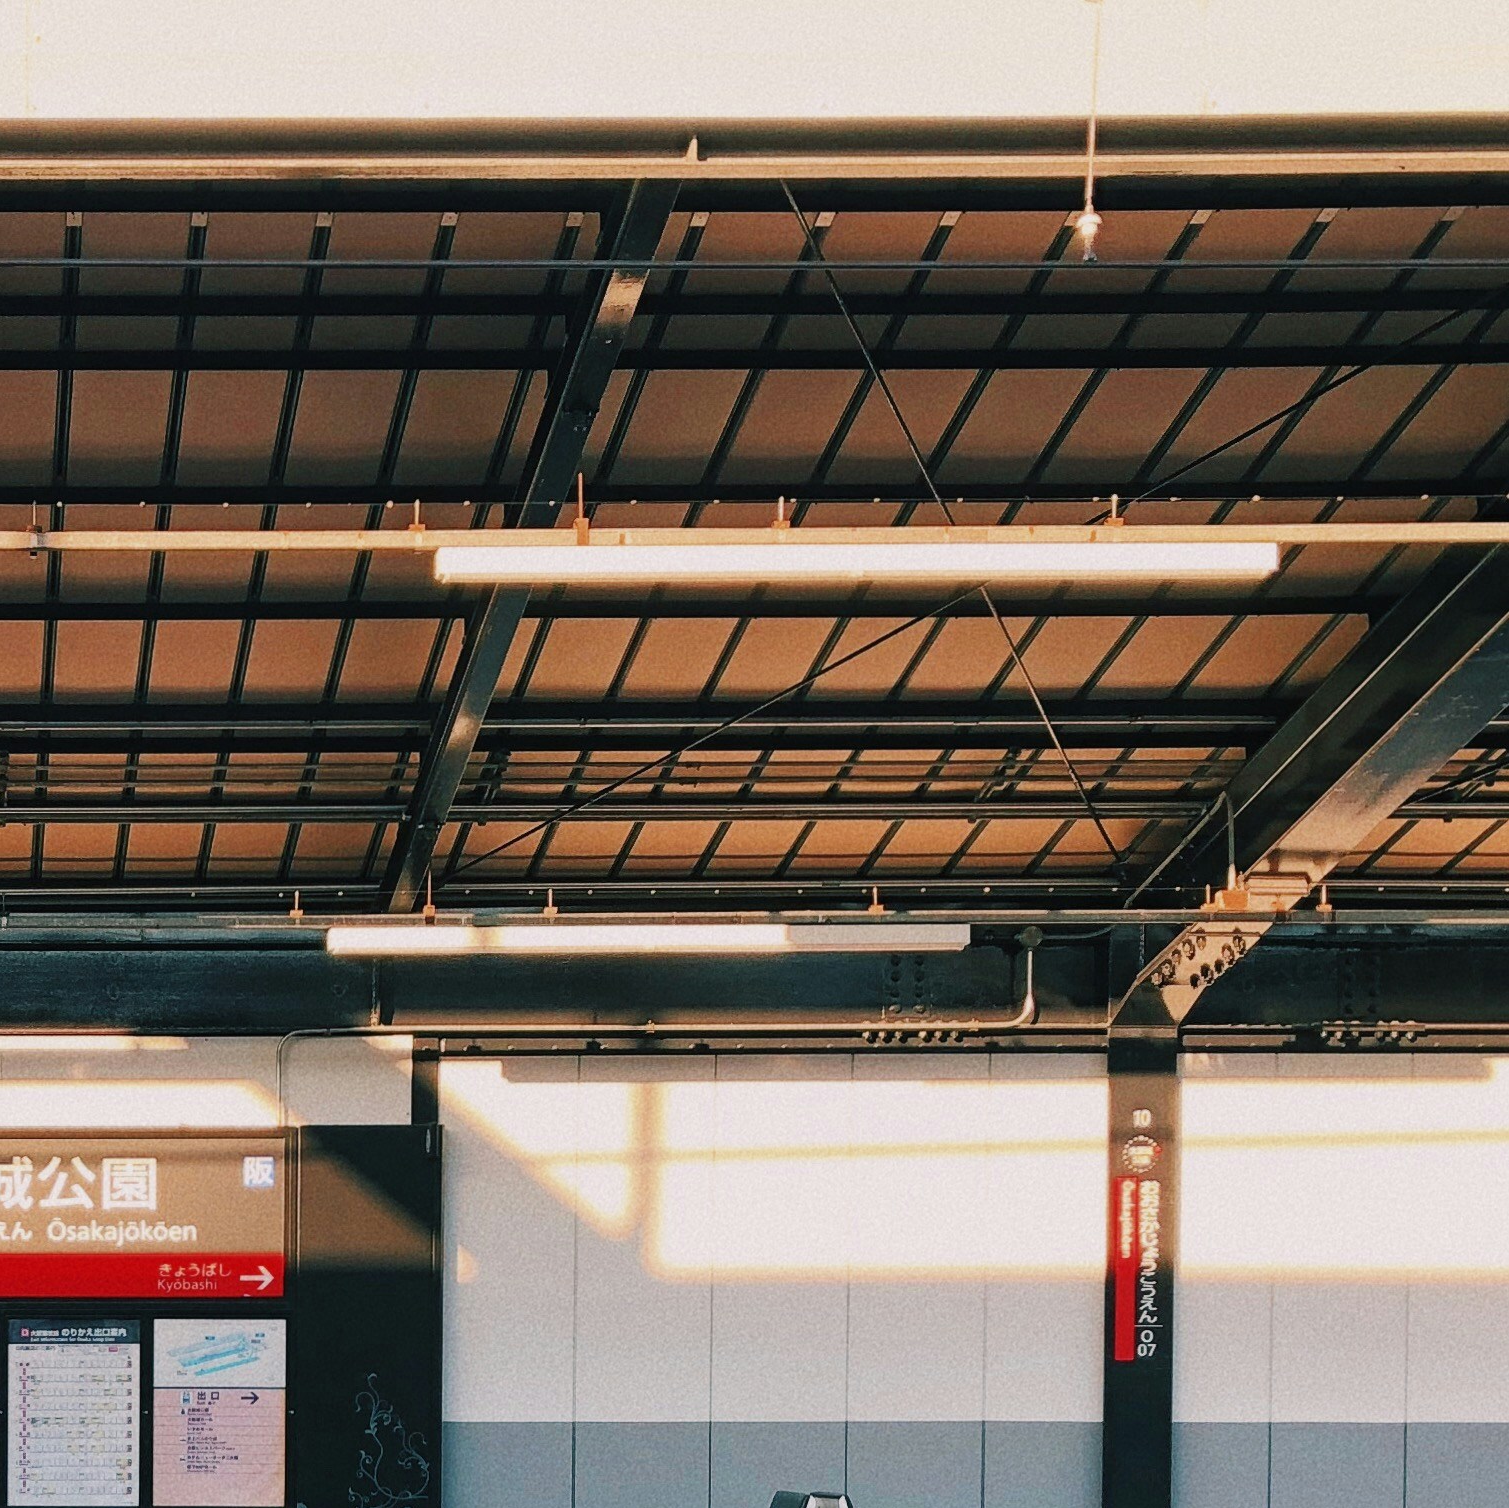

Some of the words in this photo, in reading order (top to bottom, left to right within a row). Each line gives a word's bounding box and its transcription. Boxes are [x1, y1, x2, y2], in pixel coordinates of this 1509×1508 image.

[1132, 1108, 1153, 1128] 10
[243, 1156, 275, 1188] 阪
[46, 1217, 198, 1247] Ōsakajōkōen
[158, 1262, 232, 1278] きょうばし
[157, 1279, 218, 1294] Kyōbashi
[1136, 1343, 1157, 1357] 07
[197, 1391, 220, 1401] 出口
